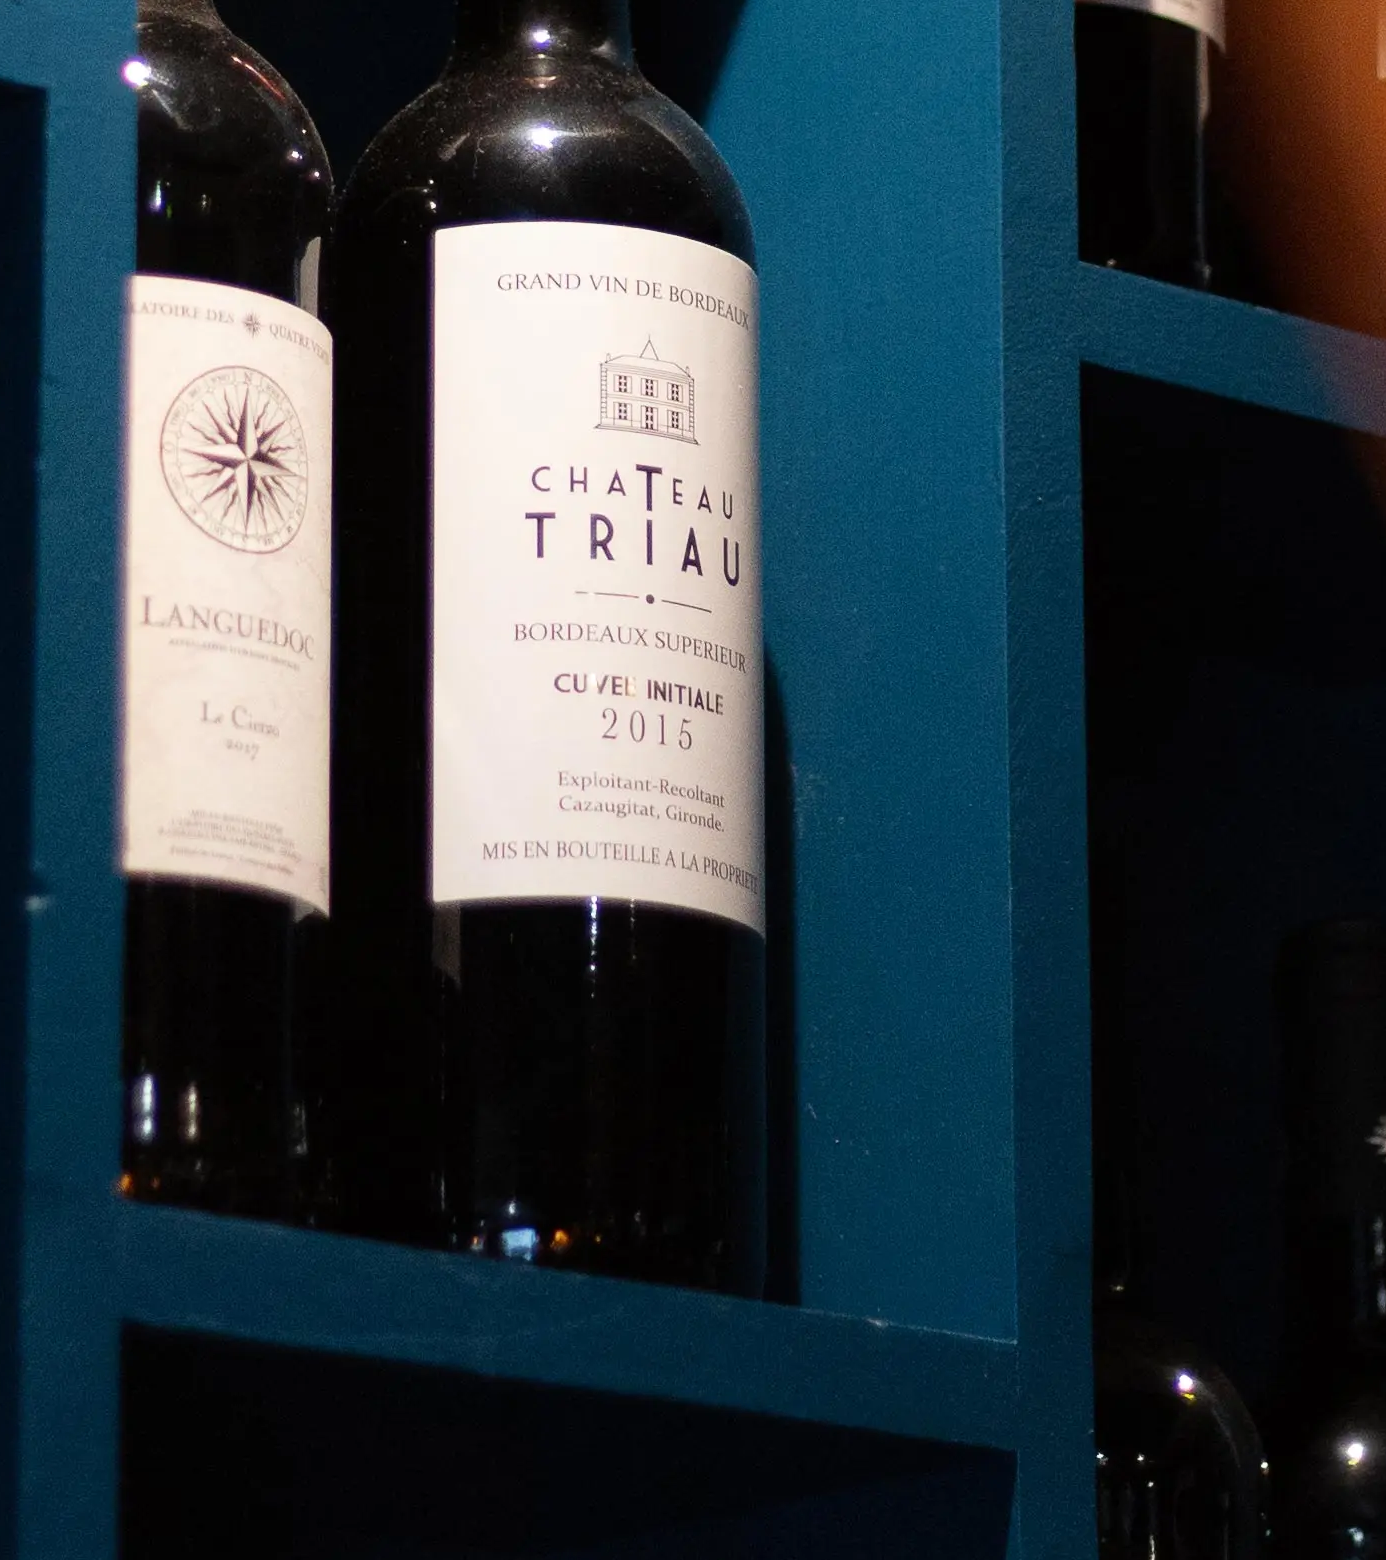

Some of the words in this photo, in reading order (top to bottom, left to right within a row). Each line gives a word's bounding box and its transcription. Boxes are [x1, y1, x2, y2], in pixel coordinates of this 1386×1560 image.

[132, 301, 199, 320] ATOIRE
[205, 308, 235, 324] DES
[269, 322, 310, 351] QUATRE
[497, 273, 581, 291] GRAND
[589, 274, 628, 293] VIN
[636, 280, 663, 300] DE
[669, 285, 750, 330] BORDEAUX
[531, 464, 733, 519] CHATEAU
[525, 512, 740, 586] TRIAU
[140, 595, 315, 661] LANGUEDOC
[514, 622, 649, 647] BORDEAUX
[654, 631, 747, 674] SUPERIEUR
[647, 679, 724, 716] INITIALE
[601, 708, 693, 750] 2015
[558, 770, 725, 808] Exploitant-Recoltant
[559, 795, 661, 820] Cazaugitat,
[665, 803, 725, 833] Gironde.
[482, 842, 517, 861] MIS
[524, 841, 549, 858] EN
[557, 840, 661, 865] BOUTEILLE
[665, 849, 677, 868] A
[681, 851, 699, 872] LA
